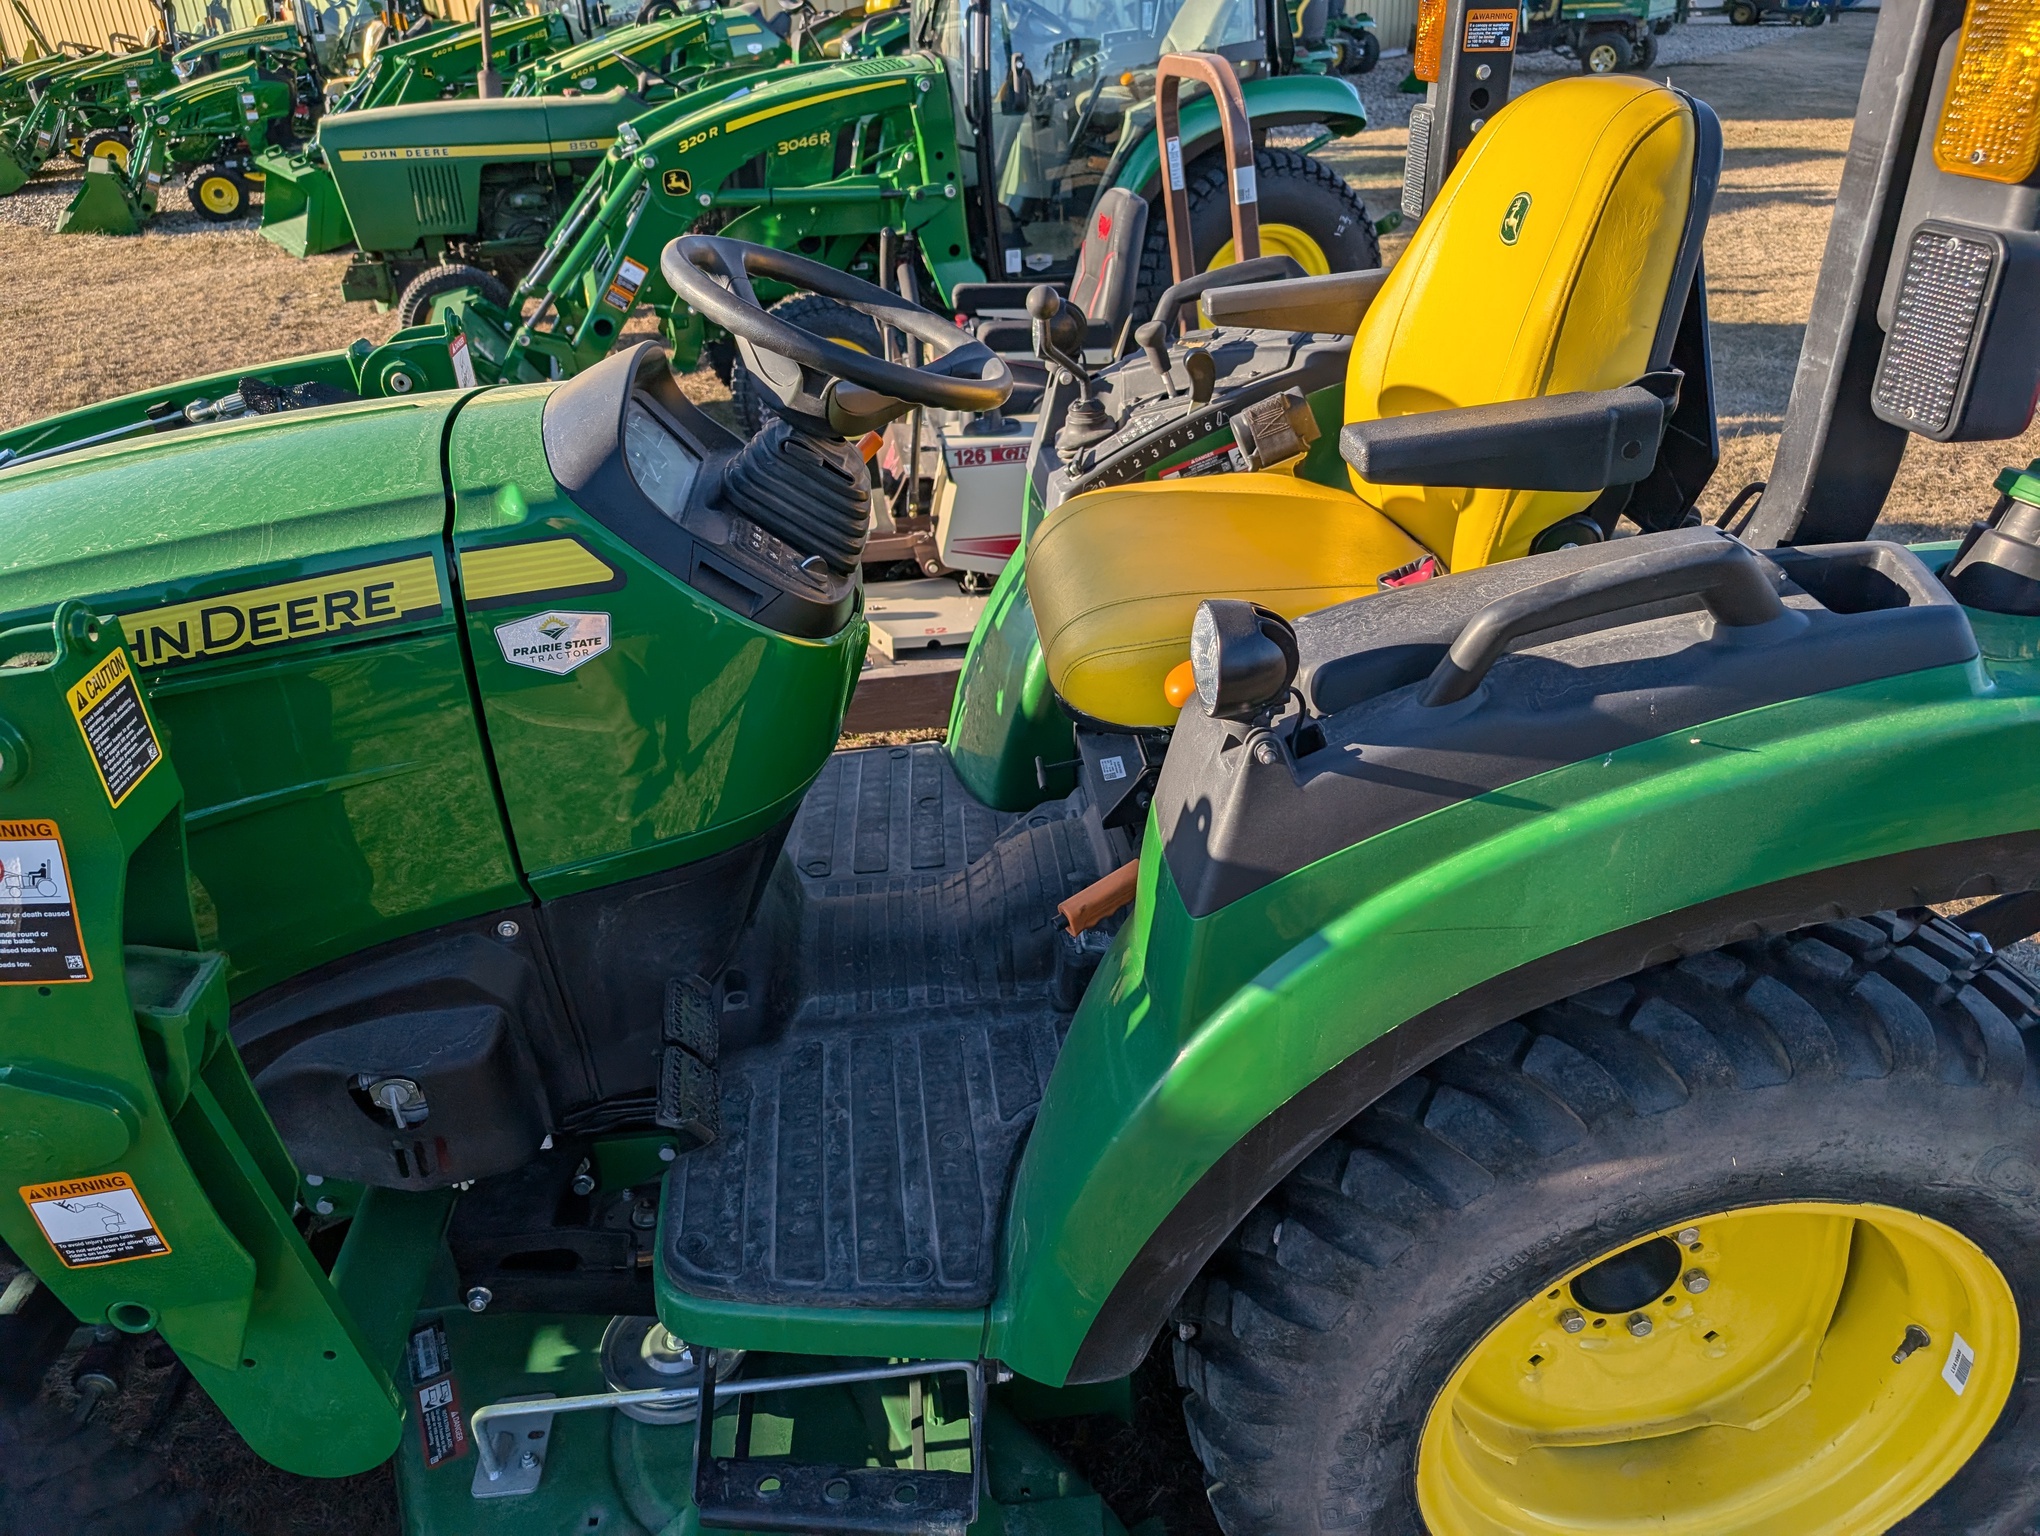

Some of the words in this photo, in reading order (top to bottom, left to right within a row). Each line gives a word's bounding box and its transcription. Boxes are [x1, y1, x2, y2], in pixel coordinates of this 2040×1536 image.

[362, 150, 397, 159] JOHN
[406, 148, 449, 158] DEERE
[569, 141, 598, 150] 850
[954, 448, 986, 466] 126
[1116, 468, 1124, 478] 1
[1133, 459, 1141, 469] 2
[1152, 448, 1159, 458] 3
[1169, 439, 1176, 448] 4
[1187, 430, 1194, 439] 5
[1205, 422, 1212, 431] 6
[129, 621, 190, 662] HN
[200, 581, 396, 650] DEERE
[925, 627, 948, 635] 52
[513, 643, 562, 657] PRAIRIE
[564, 637, 602, 650] STATE
[530, 649, 589, 663] TRACTOR
[85, 653, 126, 700] CAUTION
[0, 824, 52, 837] NING
[41, 1176, 126, 1198] WARNING
[72, 1255, 111, 1263] attachments.
[453, 1417, 464, 1442] DANGER
